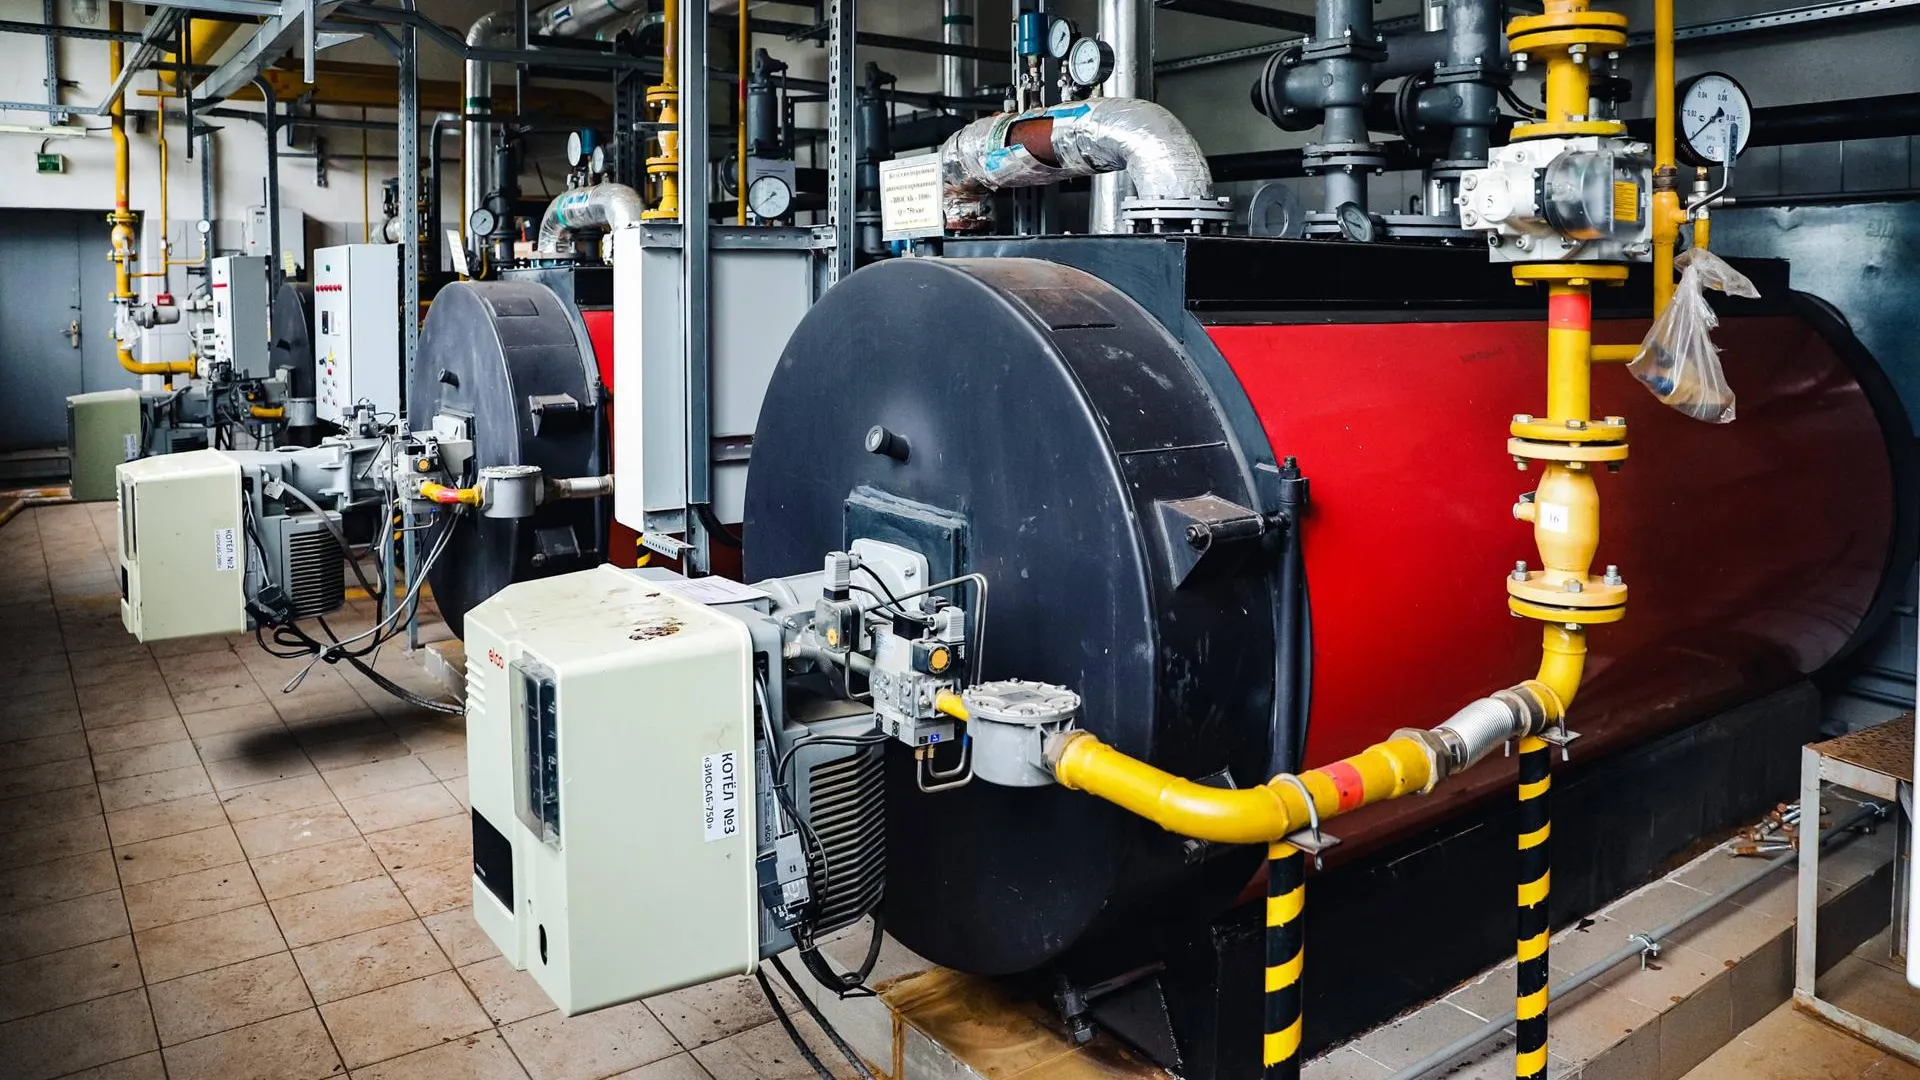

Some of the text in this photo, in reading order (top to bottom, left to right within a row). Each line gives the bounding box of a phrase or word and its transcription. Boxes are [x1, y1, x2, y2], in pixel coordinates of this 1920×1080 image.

[226, 556, 234, 569] №2
[488, 647, 504, 669] elco
[704, 757, 714, 829] «ЗИОСАБ-750»
[722, 752, 736, 835] КОТЁЛ №3
